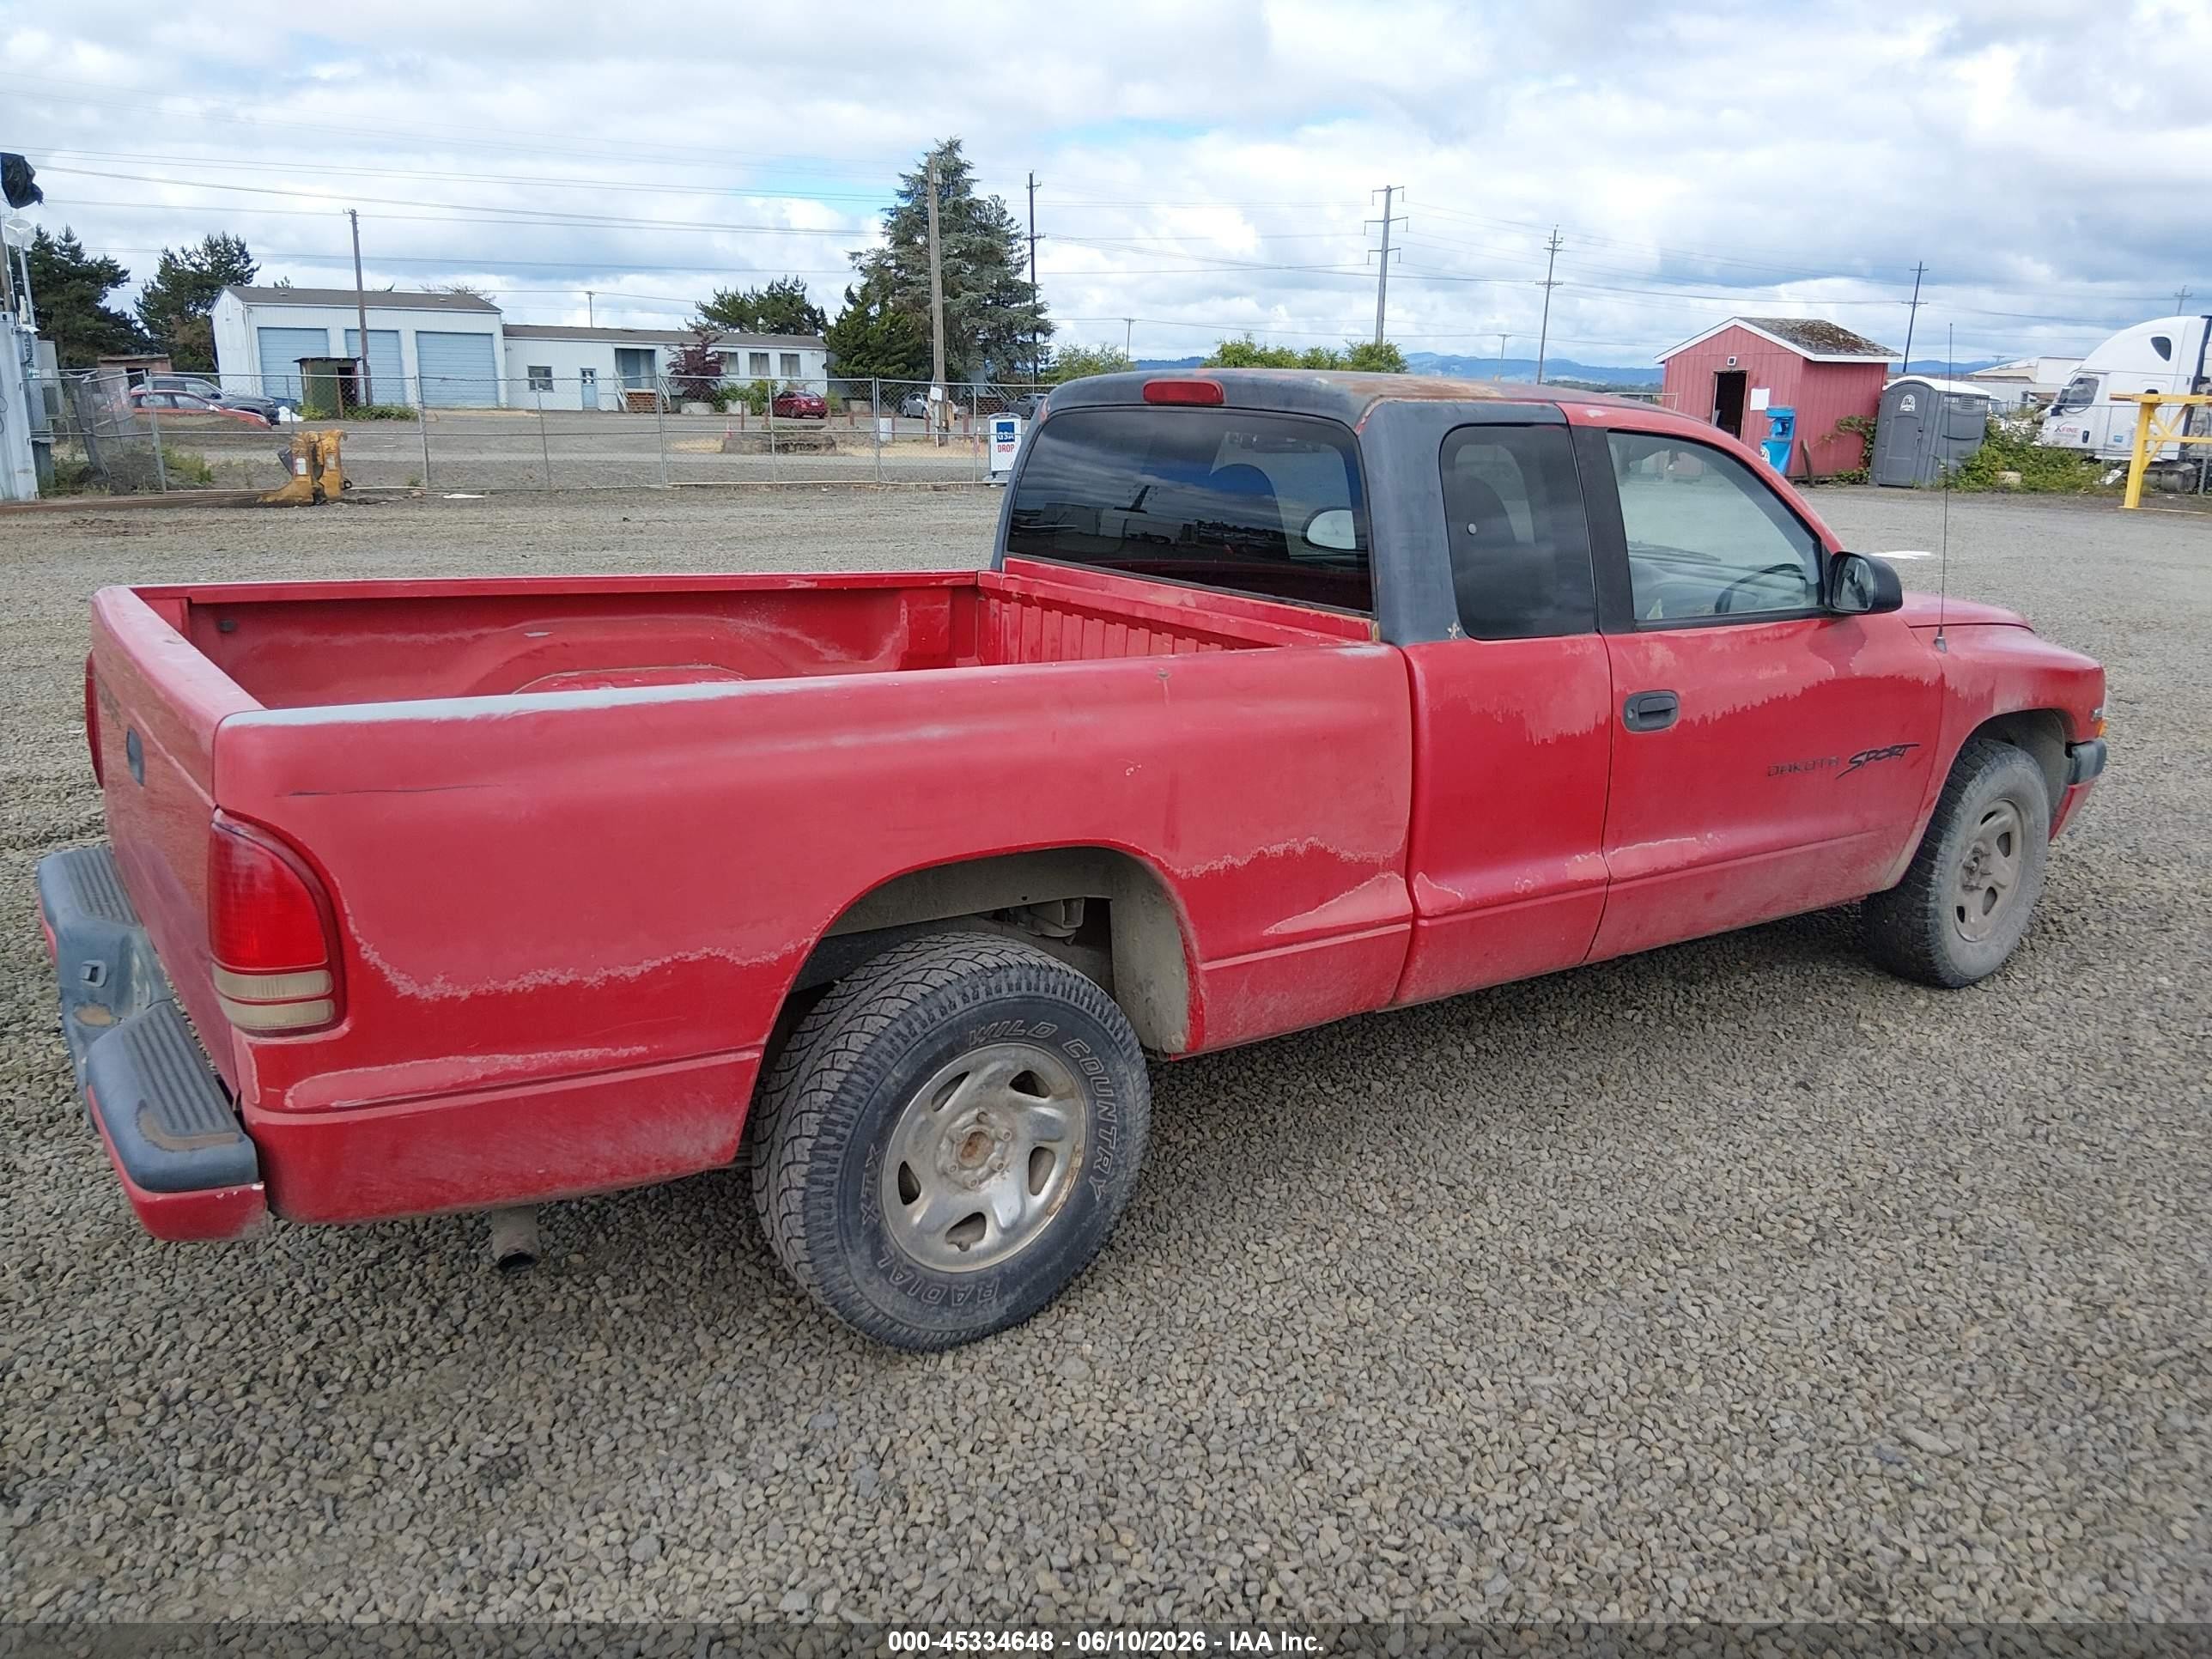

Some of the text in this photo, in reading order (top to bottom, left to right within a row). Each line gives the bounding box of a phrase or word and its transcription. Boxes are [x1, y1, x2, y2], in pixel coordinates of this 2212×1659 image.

[997, 431, 1015, 441] GSA
[997, 444, 1015, 453] DROP
[1767, 743, 1920, 781] DAKOTA SPORT
[968, 1019, 1118, 1203] WILD COUNTRY
[876, 1245, 1000, 1307] RADIAL
